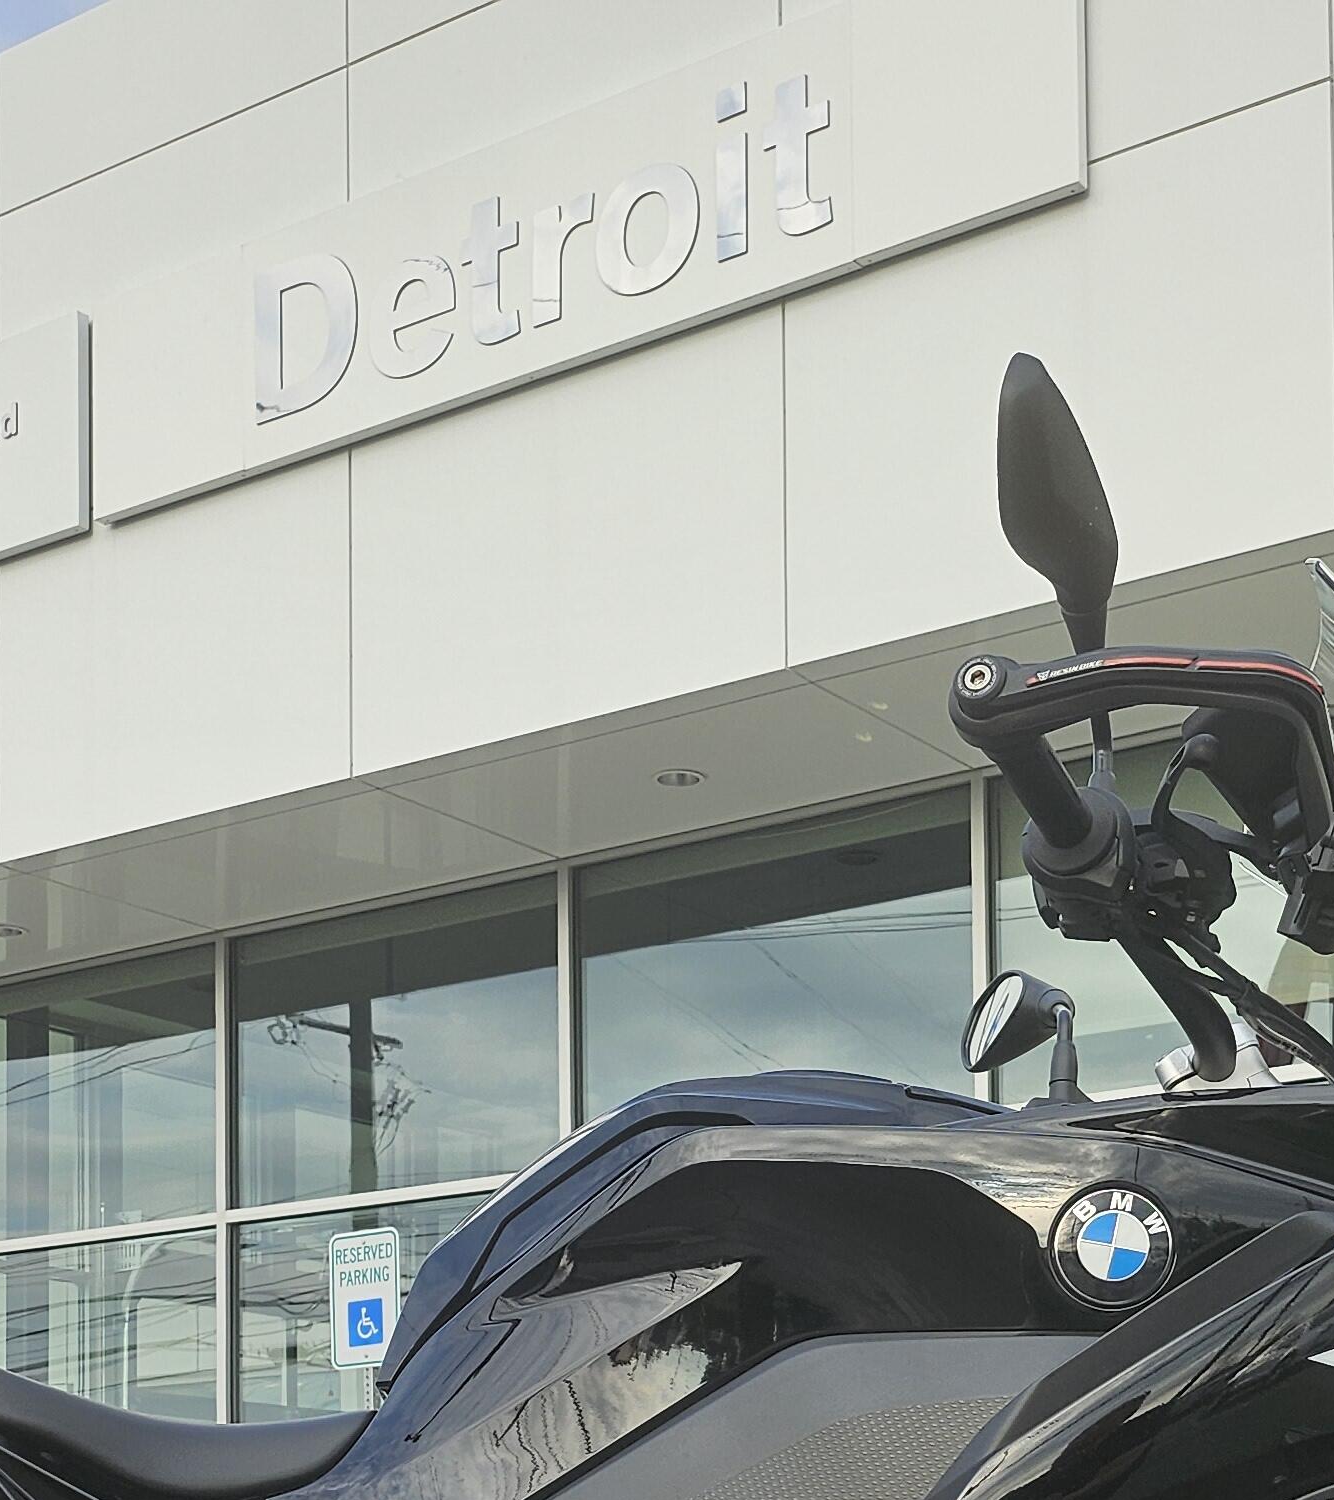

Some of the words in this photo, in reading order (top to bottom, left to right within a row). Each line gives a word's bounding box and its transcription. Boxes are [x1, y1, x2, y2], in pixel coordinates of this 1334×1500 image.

[254, 74, 834, 426] Detroit
[1072, 1191, 1167, 1235] BMW
[335, 1242, 393, 1266] RESERVED
[339, 1265, 390, 1288] PARKING
